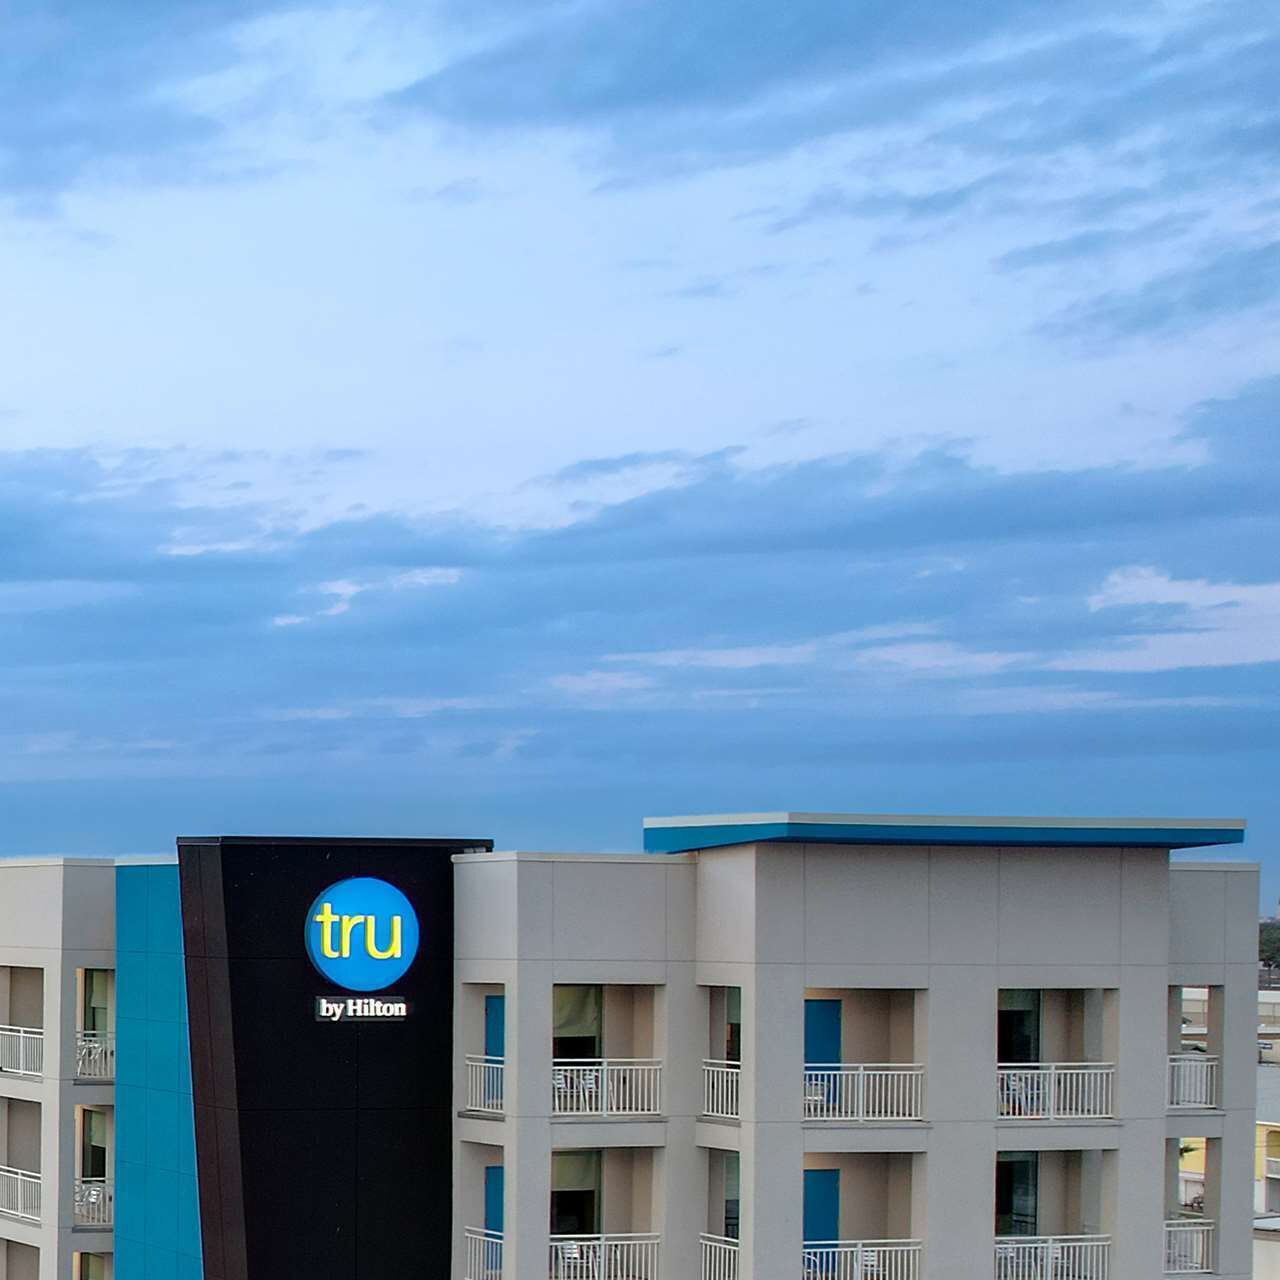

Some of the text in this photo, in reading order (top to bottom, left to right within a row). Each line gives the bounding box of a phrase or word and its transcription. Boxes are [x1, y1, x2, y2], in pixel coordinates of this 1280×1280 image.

[314, 902, 403, 960] tru
[319, 998, 407, 1021] by Hilton
